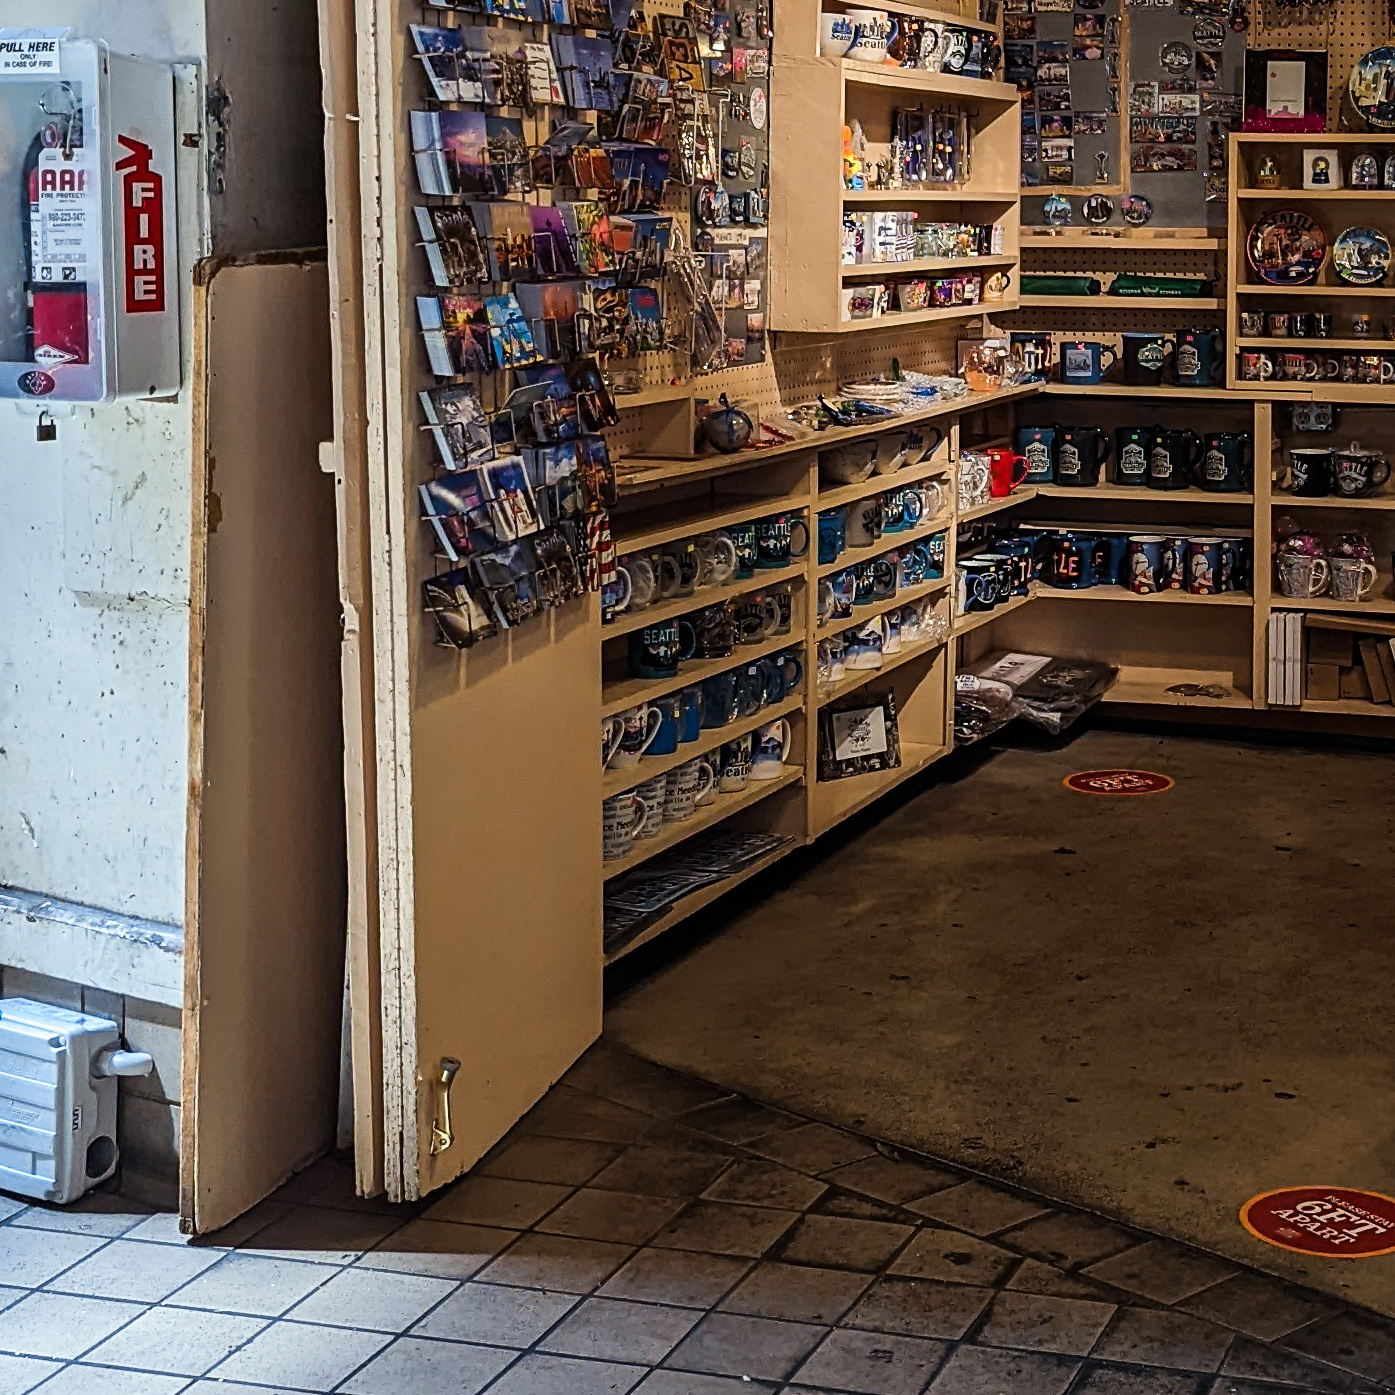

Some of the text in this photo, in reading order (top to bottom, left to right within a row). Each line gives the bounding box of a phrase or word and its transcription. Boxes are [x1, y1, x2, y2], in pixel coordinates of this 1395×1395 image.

[28, 42, 55, 52] HERE
[132, 182, 155, 300] FIRE
[644, 629, 679, 644] SEATTL
[1271, 1208, 1356, 1245] APART
[1296, 1201, 1387, 1236] 6FT
